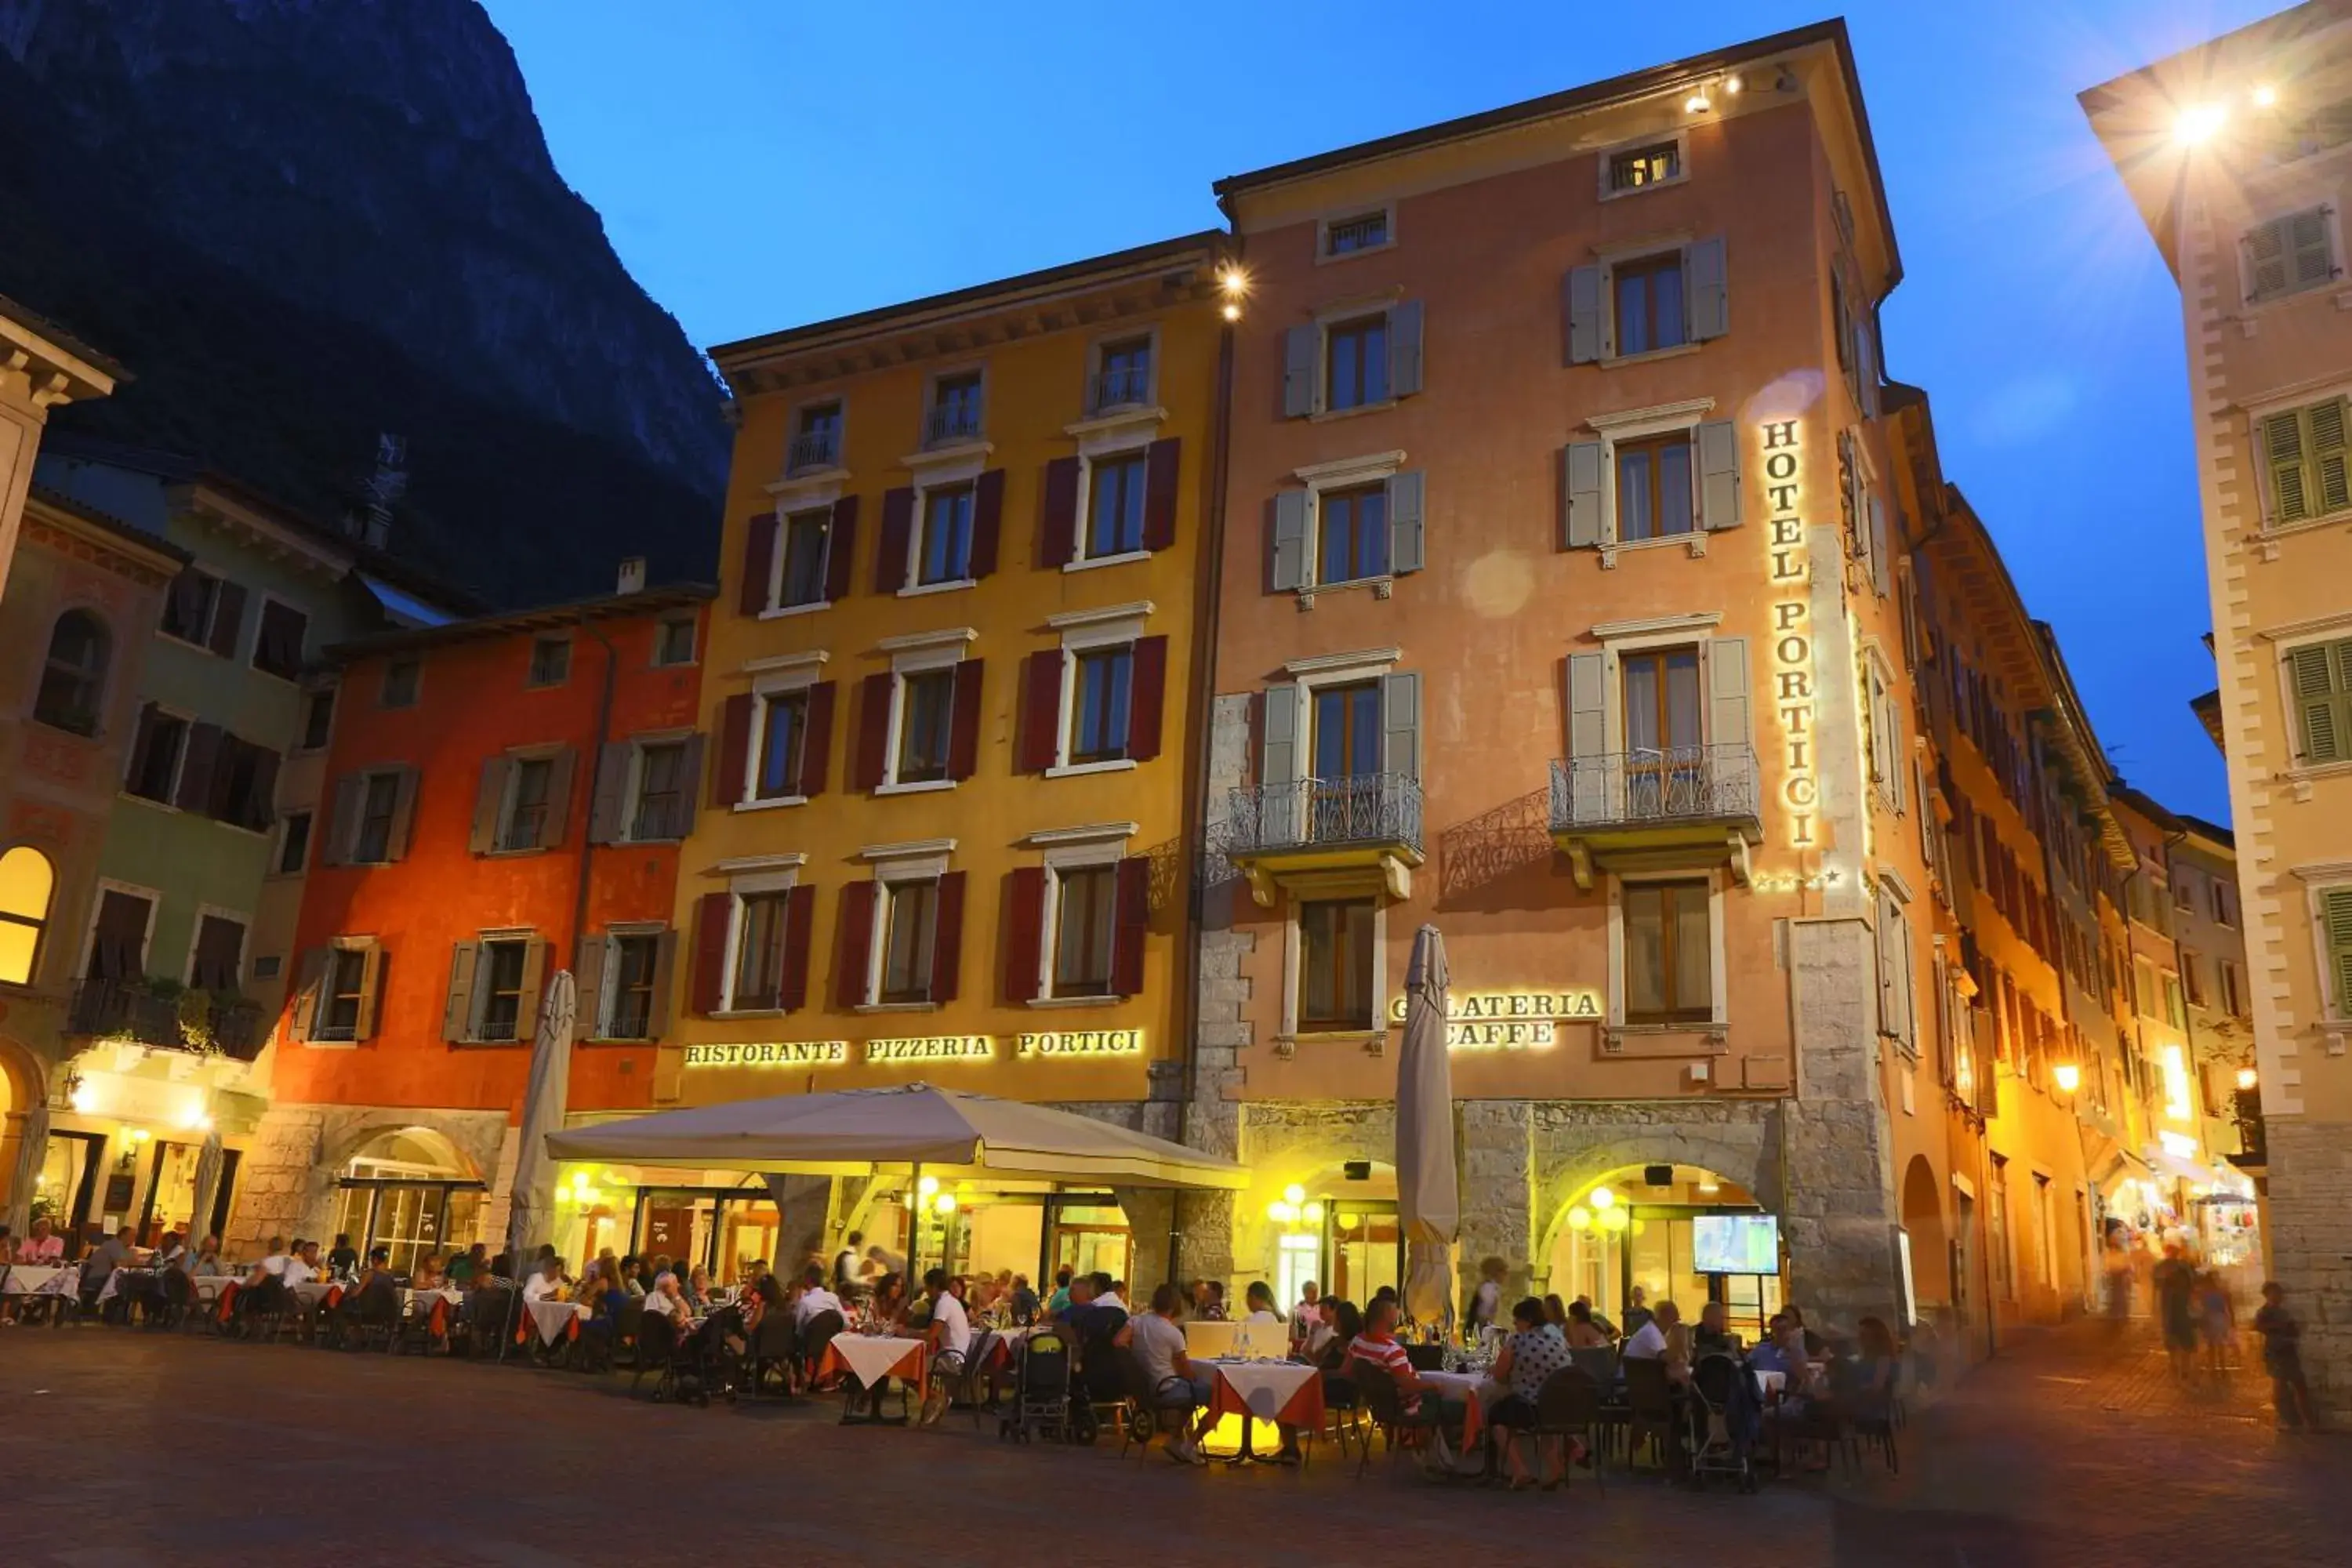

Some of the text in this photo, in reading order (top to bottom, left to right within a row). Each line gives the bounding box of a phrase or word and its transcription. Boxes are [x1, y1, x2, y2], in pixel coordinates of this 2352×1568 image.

[1763, 420, 1815, 843] HOTEL PORTICI
[1392, 994, 1598, 1018] GLATERIA
[686, 1031, 1137, 1062] RISTORANTE PIZZERIA PORTICI
